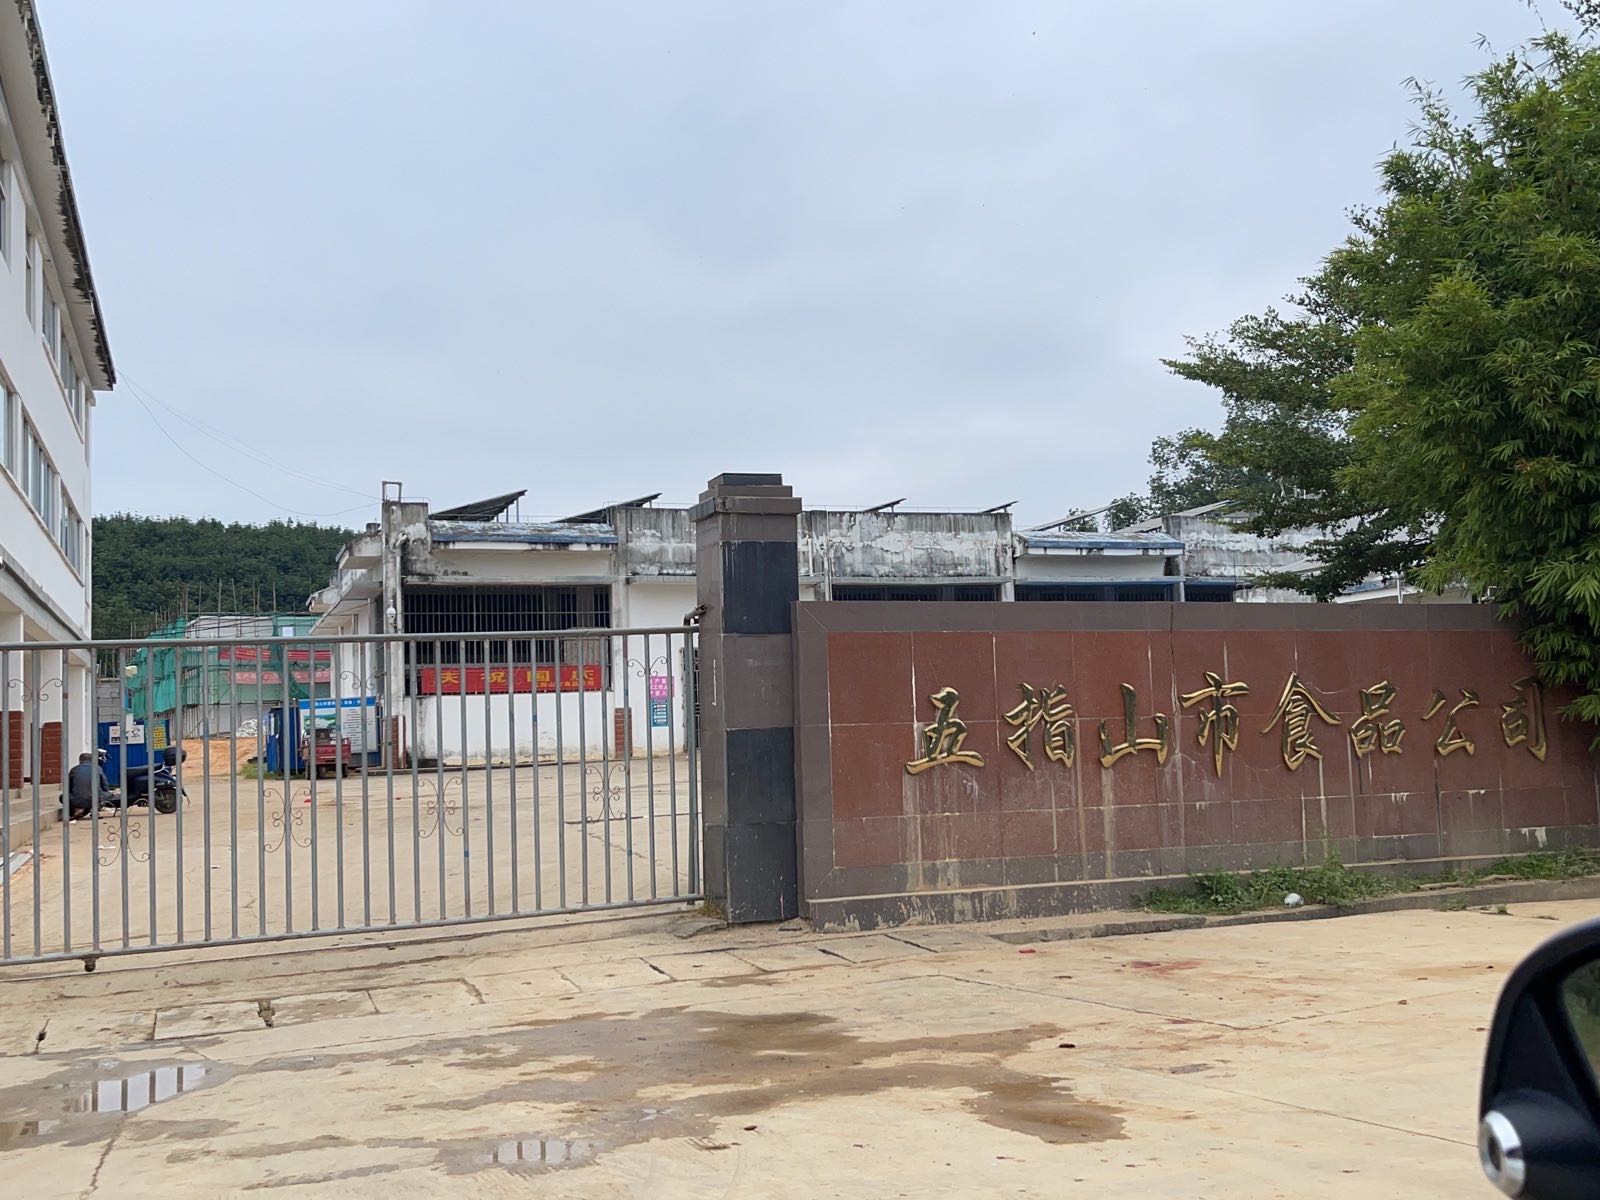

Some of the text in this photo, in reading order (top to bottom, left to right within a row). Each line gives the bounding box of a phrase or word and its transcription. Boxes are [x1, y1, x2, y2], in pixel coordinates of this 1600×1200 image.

[906, 671, 1547, 778] 五指山市食品公司
